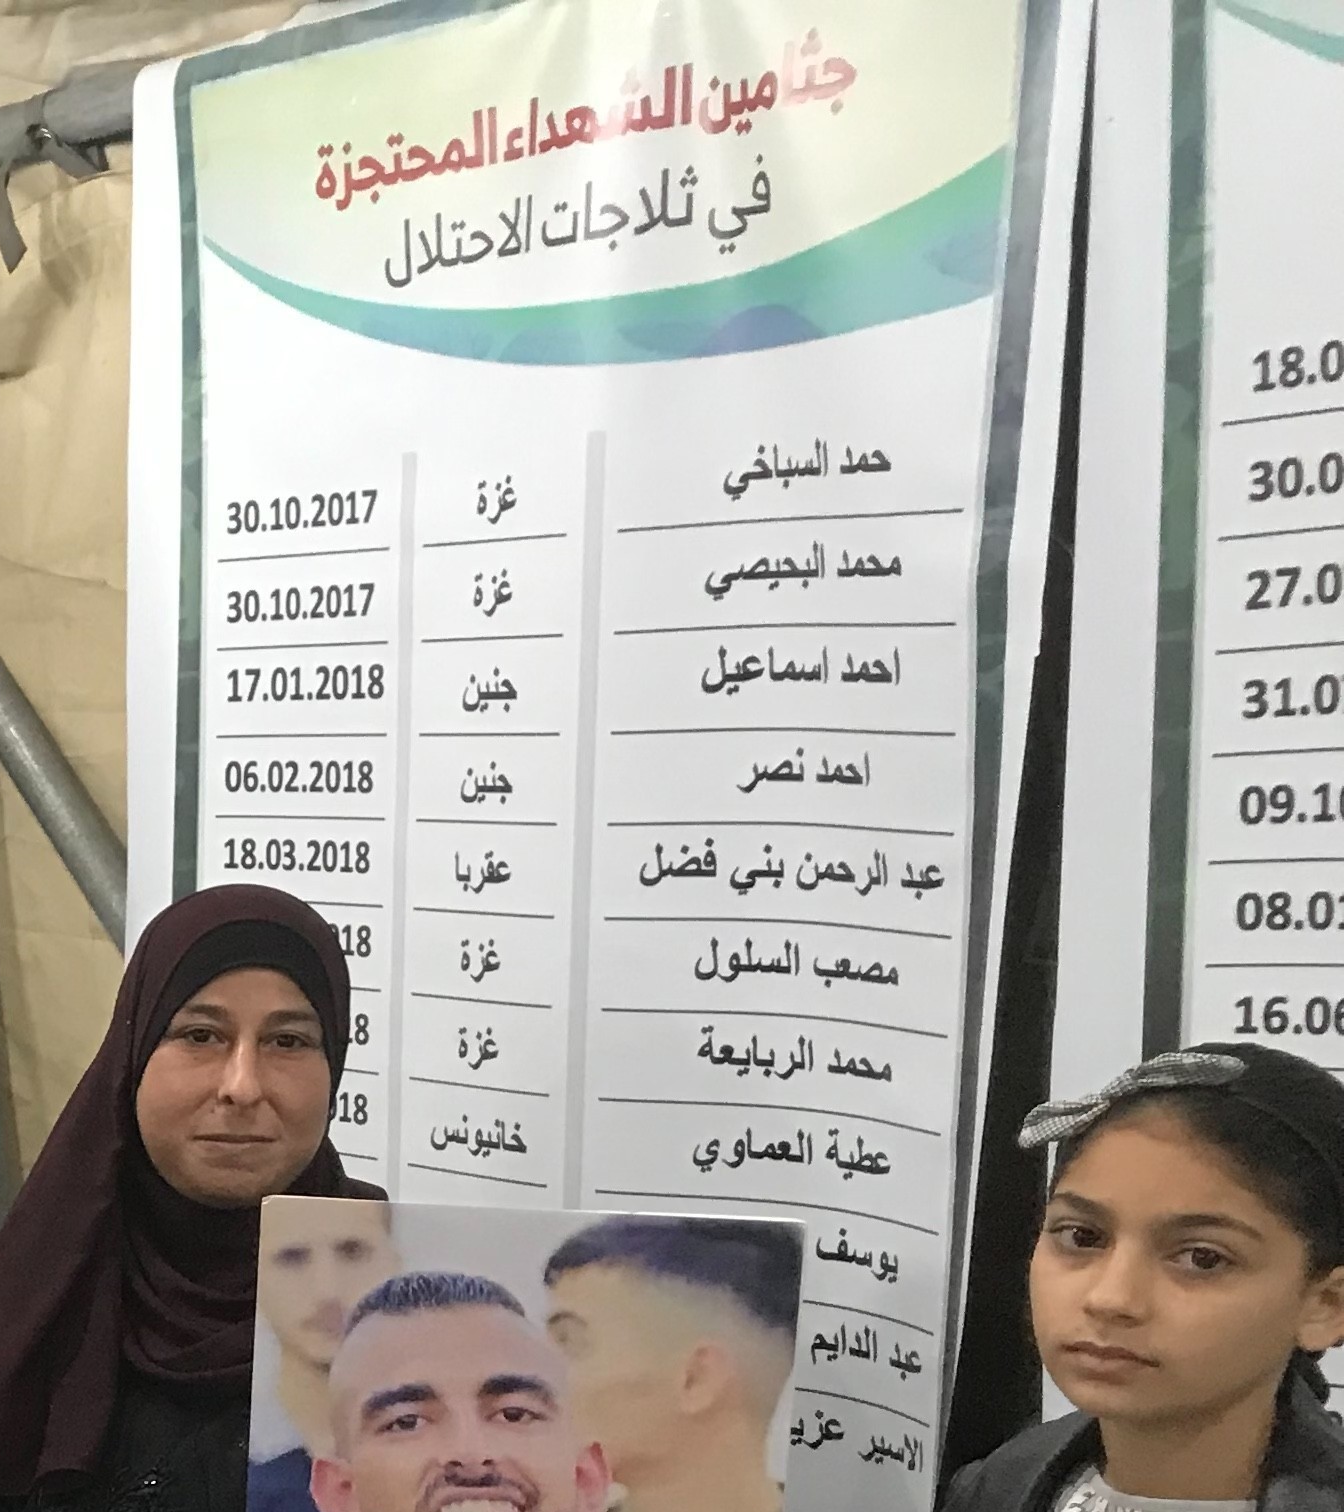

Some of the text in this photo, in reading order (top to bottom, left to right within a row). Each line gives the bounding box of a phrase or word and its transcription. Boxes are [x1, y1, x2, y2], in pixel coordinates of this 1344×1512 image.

[316, 28, 858, 211] جثامين الشهداء المحتجزة
[385, 154, 771, 288] في ثلاجات الاحتلال
[840, 447, 891, 474] حمد
[227, 490, 377, 534] 30.10.2017
[477, 475, 516, 524] غزة
[474, 569, 512, 617] غزة
[705, 541, 901, 601] محمد البحيصي
[227, 583, 374, 623] 30.10.2017
[228, 664, 384, 702] 17.01.2018
[463, 668, 517, 712] جنين
[702, 646, 900, 696] احمد اسماعيل
[225, 761, 373, 793] 06.02.2018
[461, 762, 512, 804] جنين
[737, 748, 870, 793] احمد نصر
[224, 839, 369, 874] 18.03.2018
[455, 851, 511, 894] عقربا
[640, 838, 944, 900] عبد الرحمن بني فضل
[461, 939, 500, 983] غزة
[695, 937, 898, 988] مصعب السلول
[459, 1027, 498, 1070] غزة
[697, 1026, 891, 1082] محمد الربايعة
[431, 1115, 527, 1158] خانيونس
[693, 1128, 890, 1180] عطية العماوي
[816, 1228, 898, 1283] يوسف
[889, 1344, 921, 1381] عبد
[858, 1435, 923, 1472] الاسير
